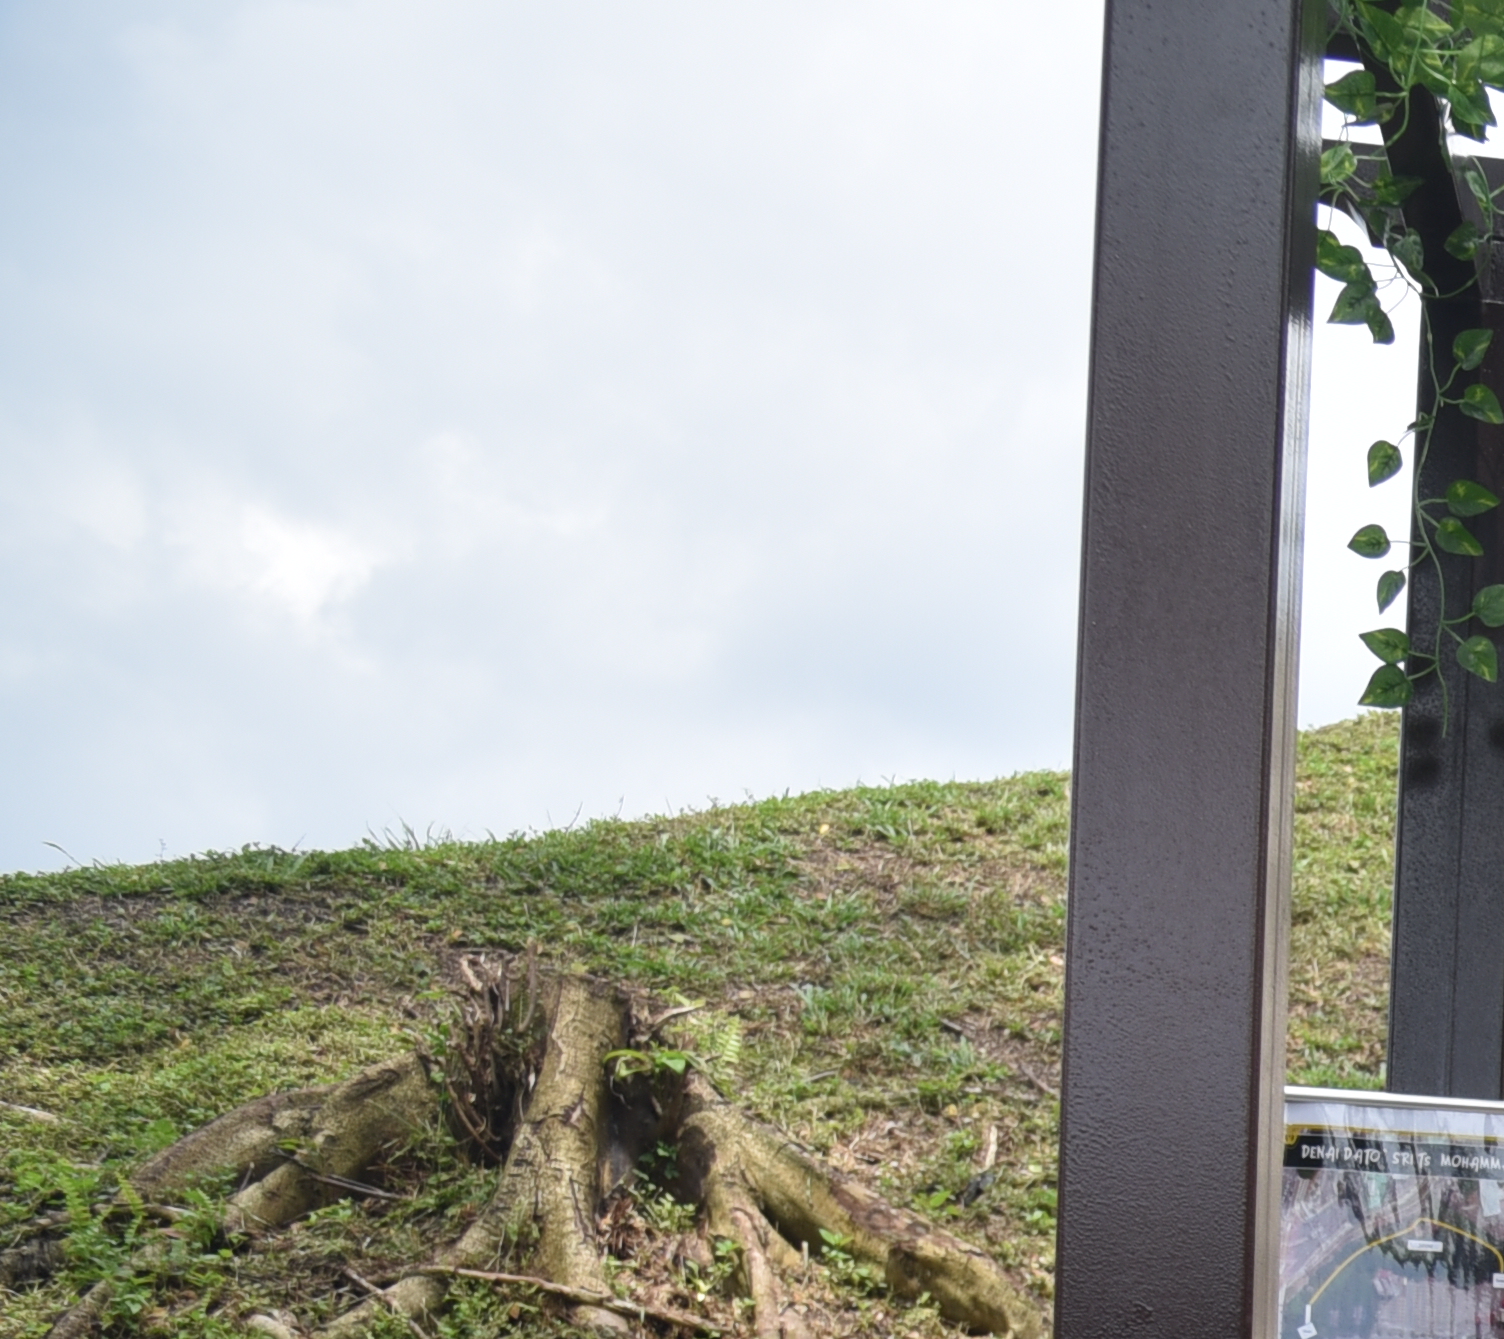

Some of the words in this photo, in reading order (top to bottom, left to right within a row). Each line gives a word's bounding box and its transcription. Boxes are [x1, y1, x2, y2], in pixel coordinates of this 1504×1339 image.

[1301, 1144, 1339, 1162] DENAI
[1391, 1151, 1413, 1166] SRI
[1417, 1152, 1431, 1168] Ts
